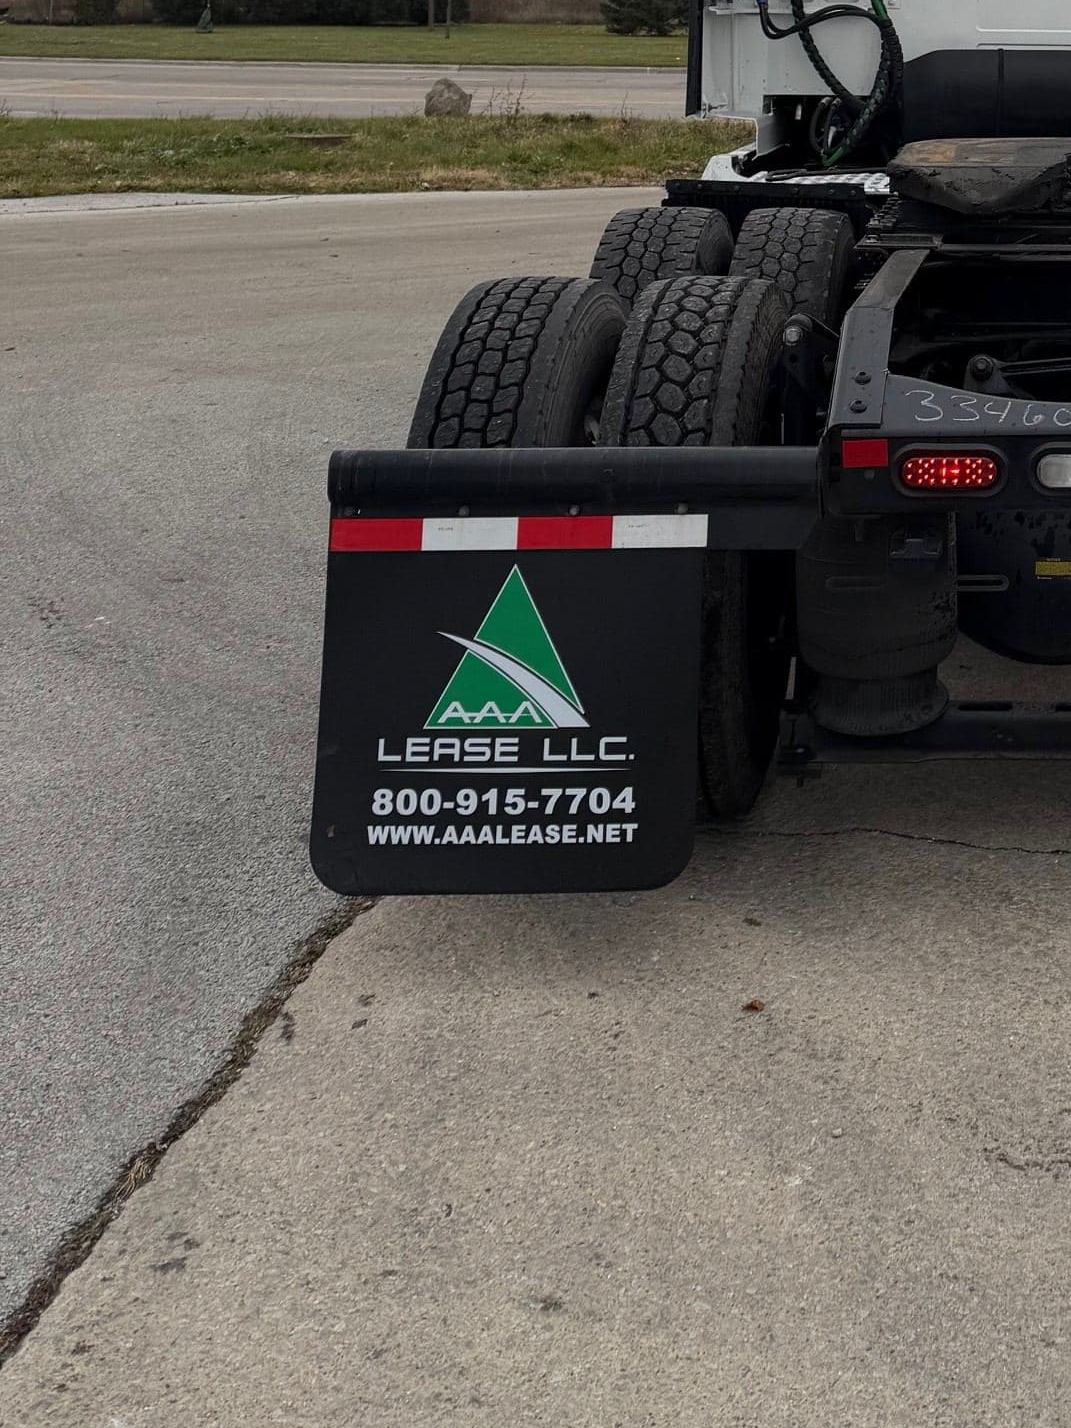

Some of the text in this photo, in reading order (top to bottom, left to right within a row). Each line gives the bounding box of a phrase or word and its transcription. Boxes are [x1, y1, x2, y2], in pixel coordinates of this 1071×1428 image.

[436, 700, 543, 724] AAA
[377, 735, 636, 763] LEASE LLC.
[371, 786, 636, 816] 800-915-7704
[366, 822, 639, 846] WWW.AAALEASE.NET
